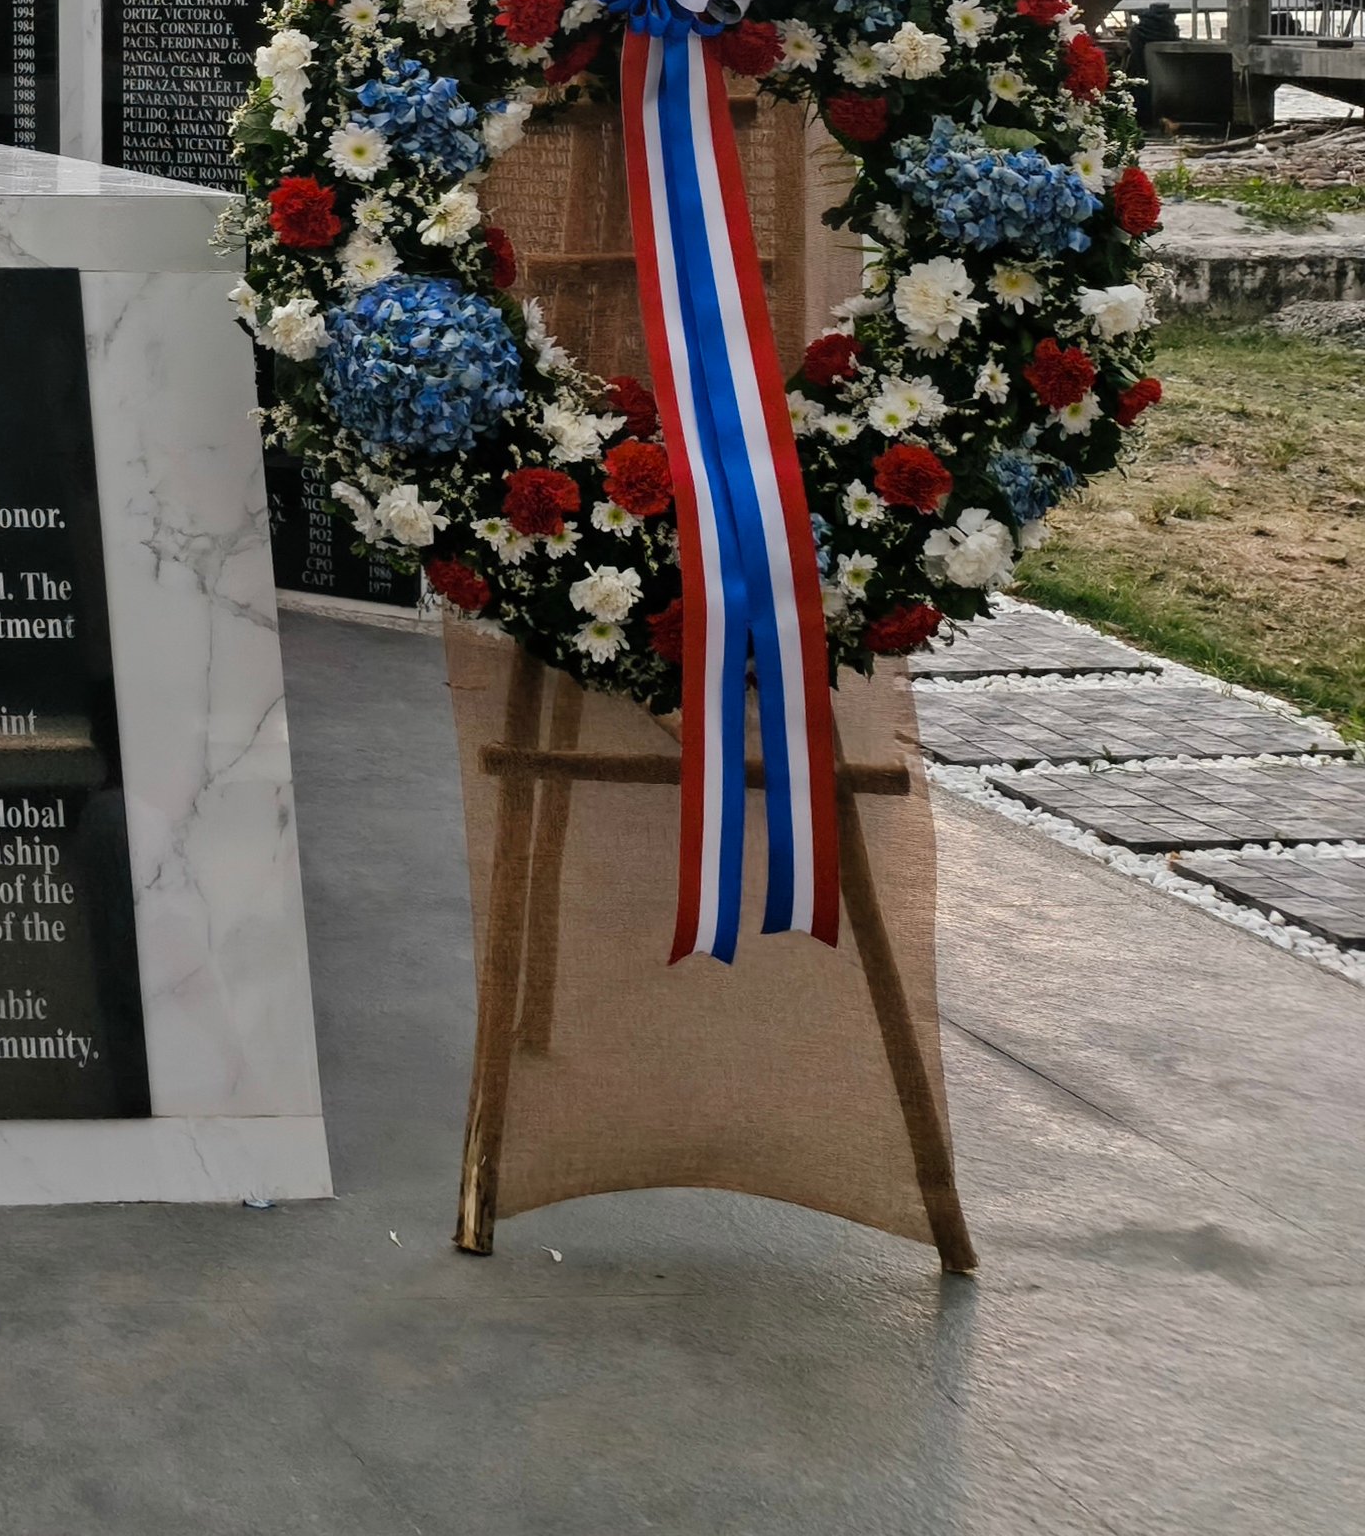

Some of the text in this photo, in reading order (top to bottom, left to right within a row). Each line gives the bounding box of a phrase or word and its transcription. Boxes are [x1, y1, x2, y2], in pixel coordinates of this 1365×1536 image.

[122, 7, 226, 21] ORTIZ, VICTOR O.
[122, 64, 223, 78] PATINO, CESAR P.
[302, 571, 391, 594] CAPT 1977
